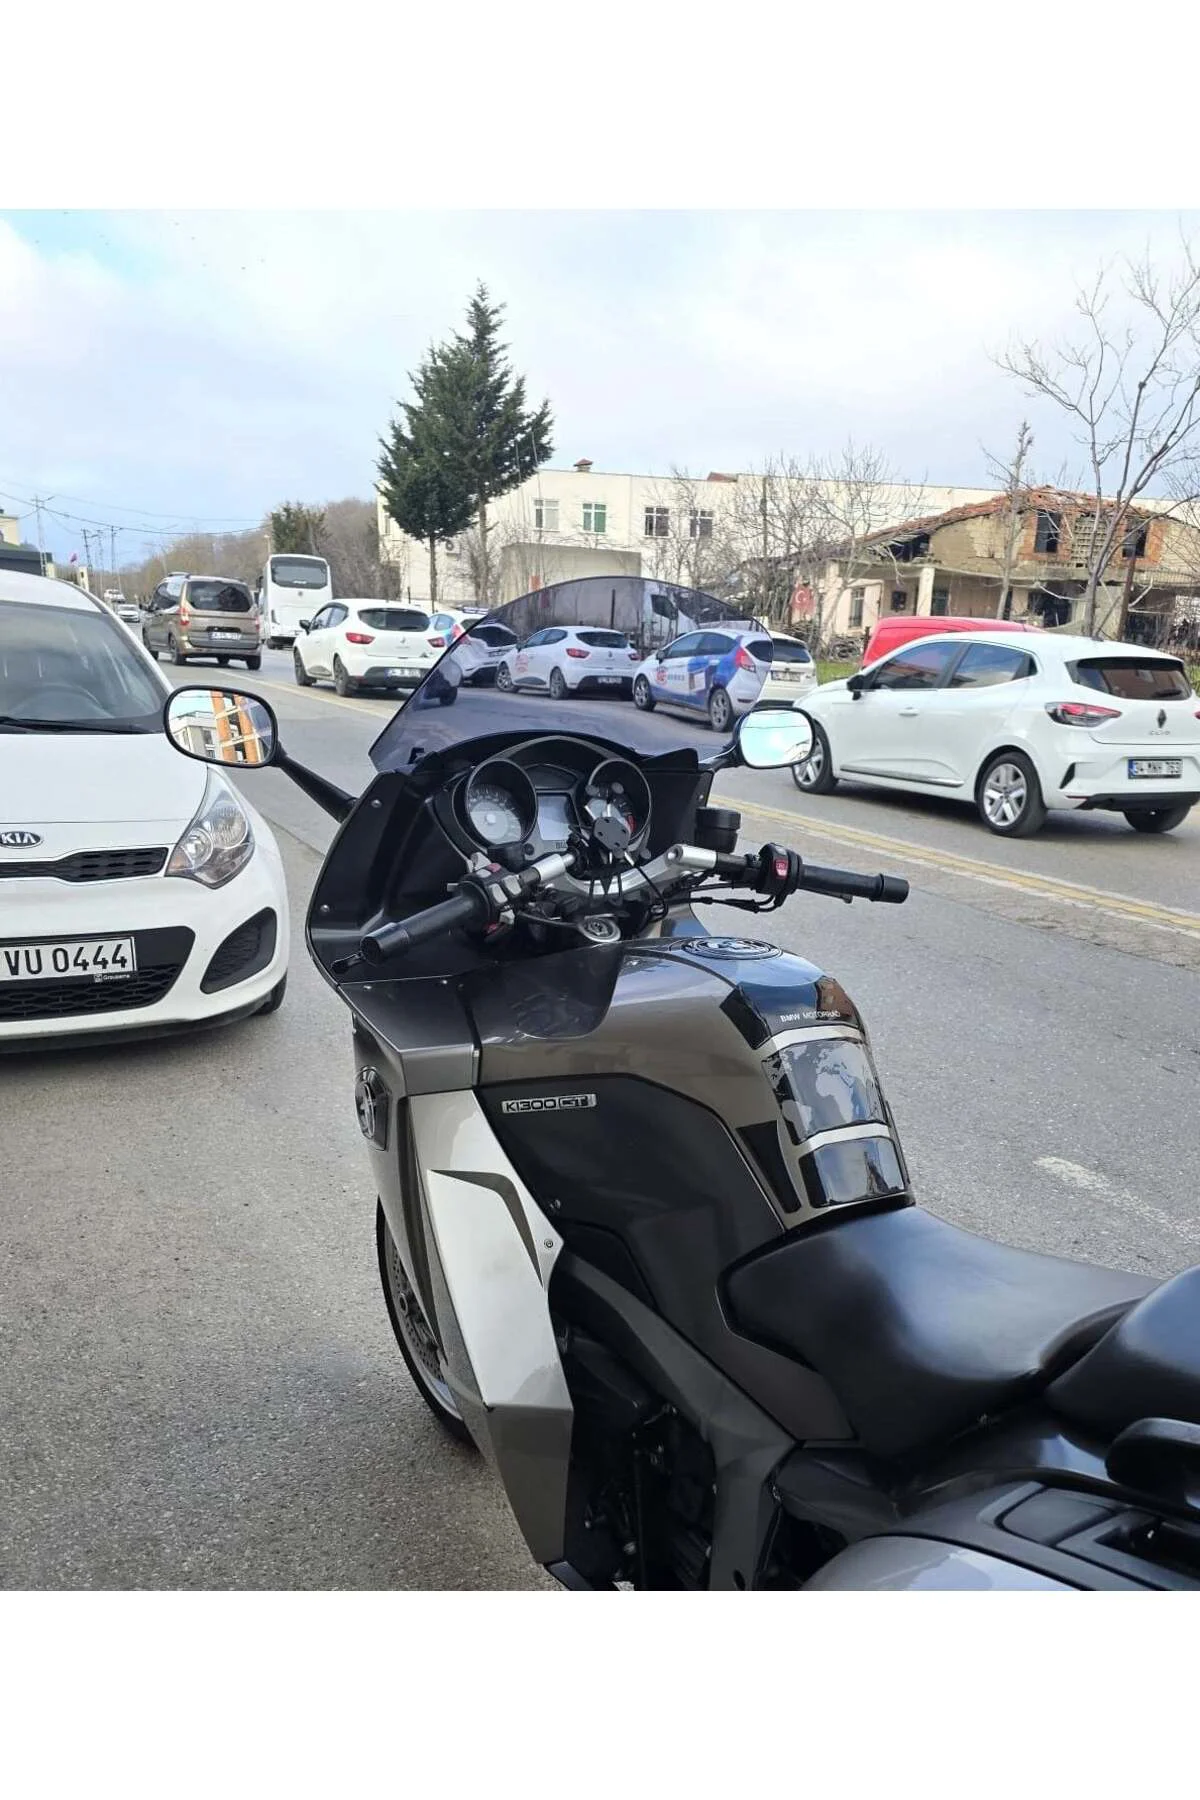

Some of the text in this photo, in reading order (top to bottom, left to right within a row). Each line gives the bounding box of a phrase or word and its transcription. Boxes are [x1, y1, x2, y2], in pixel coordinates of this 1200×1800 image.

[1, 832, 37, 844] KIA
[4, 944, 128, 976] VU 0444
[780, 1013, 800, 1023] BMW
